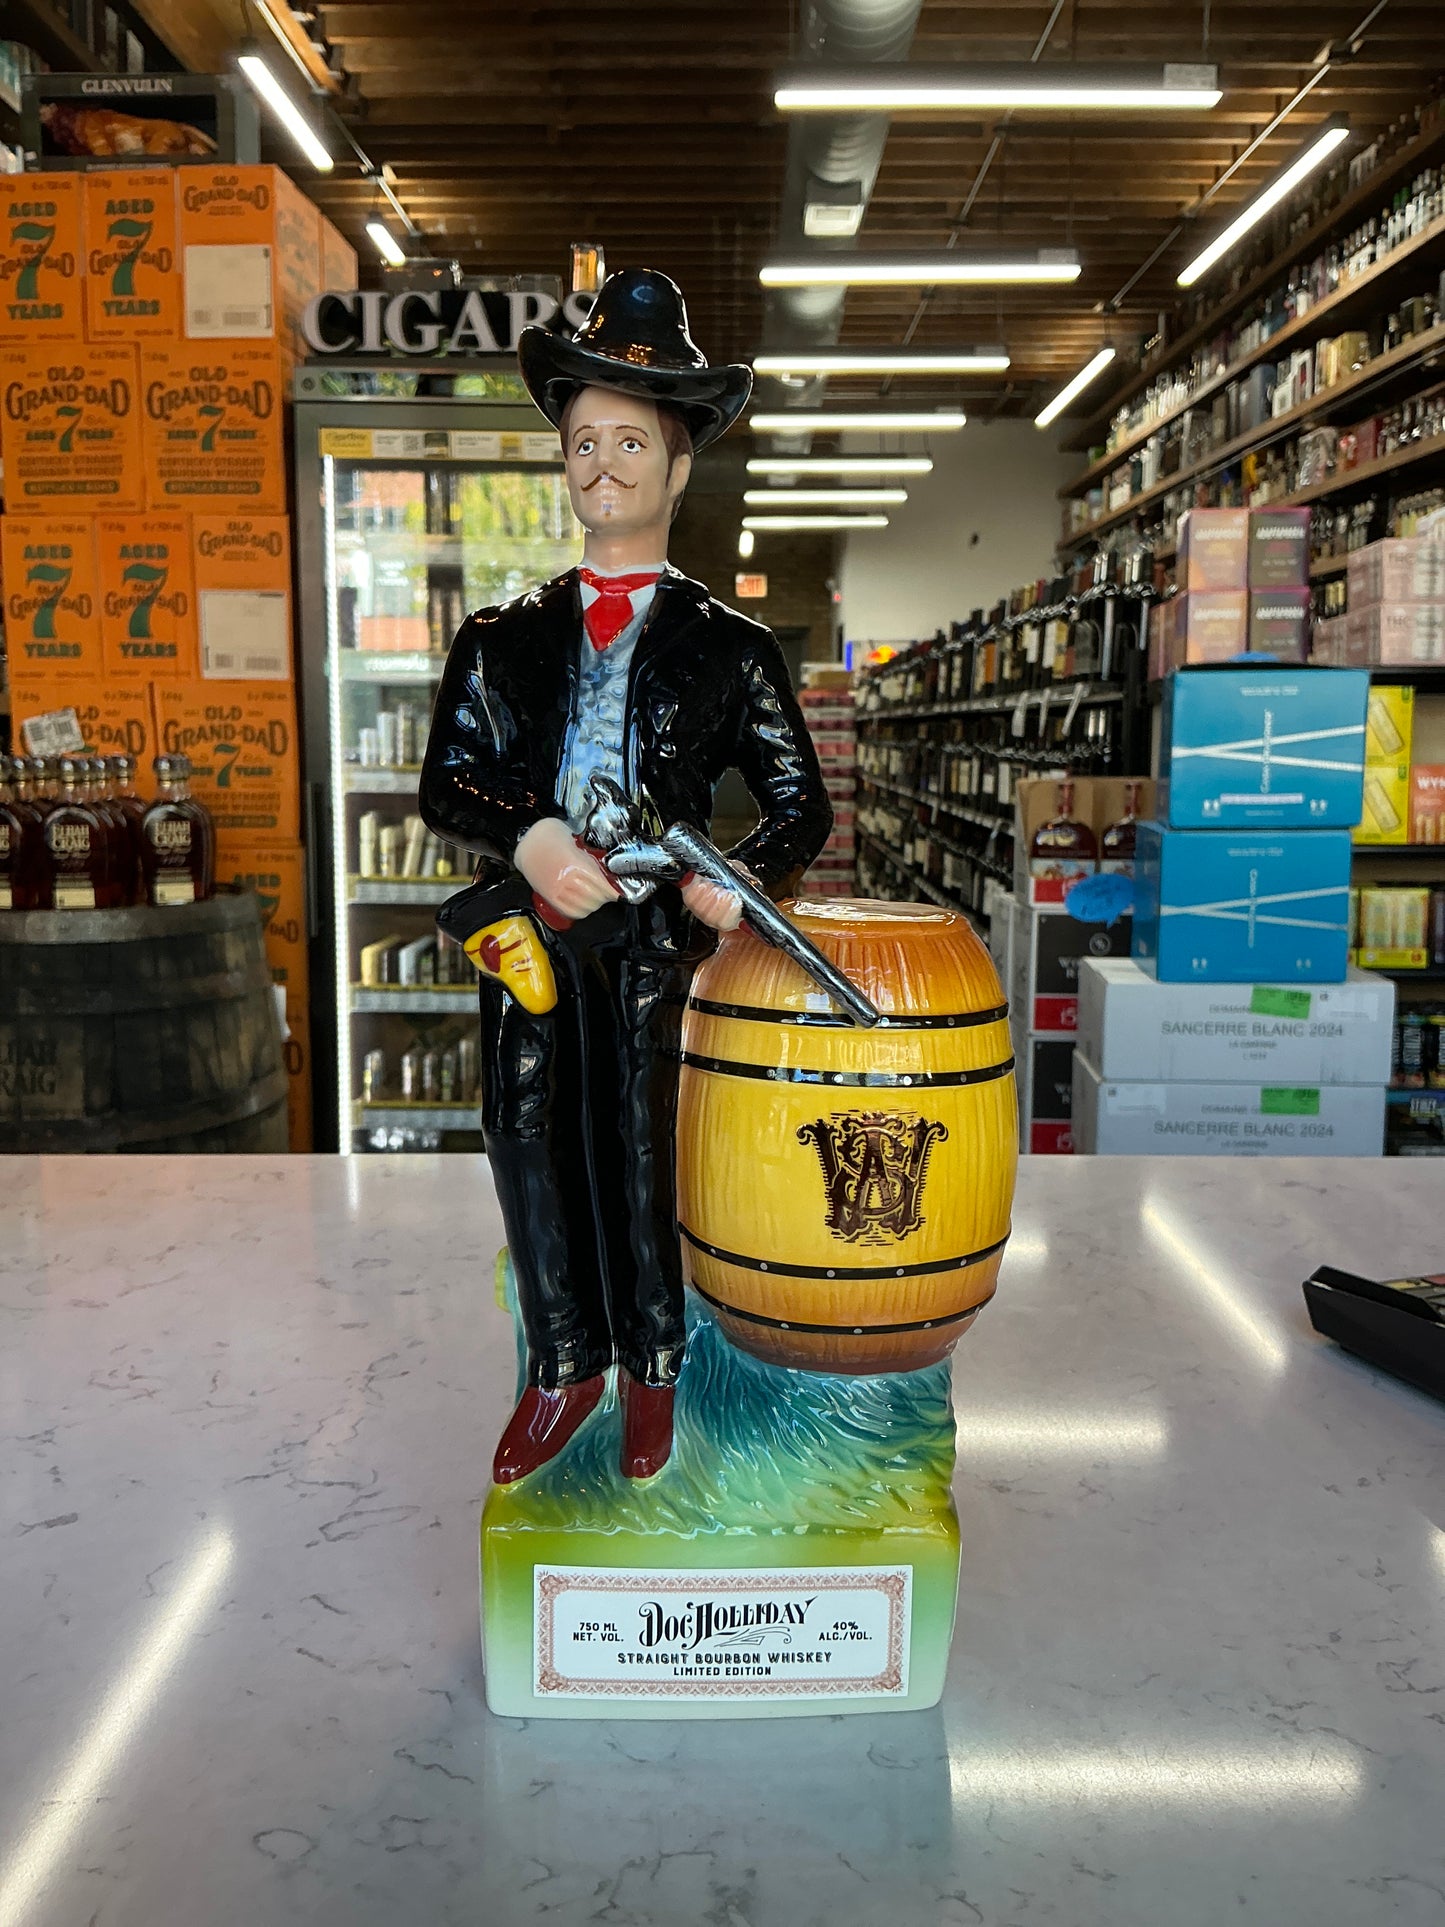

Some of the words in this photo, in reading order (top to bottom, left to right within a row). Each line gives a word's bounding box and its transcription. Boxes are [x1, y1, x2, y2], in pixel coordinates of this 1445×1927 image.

[8, 202, 57, 218] AGED
[105, 199, 155, 215] AGED
[10, 221, 56, 300] 7
[107, 218, 153, 296] 7
[7, 303, 63, 320] YEARS
[103, 300, 160, 317] YEARS
[47, 365, 85, 381] OLD
[189, 366, 228, 382] OLD
[24, 544, 72, 559] AGED
[119, 544, 169, 559] AGED
[27, 564, 73, 638] 7
[123, 563, 168, 638] 7
[24, 643, 82, 658] YEARS
[119, 643, 178, 658] YEARS
[76, 705, 99, 720] LD
[205, 705, 242, 721] OLD
[1161, 1021, 1247, 1037] SANCERRE
[1252, 1021, 1304, 1038] BLANC
[1309, 1022, 1344, 1038] 2024
[1153, 1121, 1239, 1138] SANCERRE
[1243, 1122, 1295, 1138] BLANC
[1300, 1122, 1334, 1138] 2024
[580, 1622, 600, 1631] 750
[603, 1622, 618, 1632] ML
[833, 1621, 858, 1631] 40%
[573, 1632, 596, 1641] NET.
[601, 1633, 624, 1642] VOL.
[819, 1632, 873, 1641] ALC./VOL.
[618, 1653, 689, 1664] STRAIGHT
[695, 1653, 761, 1664] BOURBON
[768, 1652, 832, 1663] WHISKEY
[673, 1667, 720, 1676] LIMITED
[725, 1667, 773, 1676] EDITION
